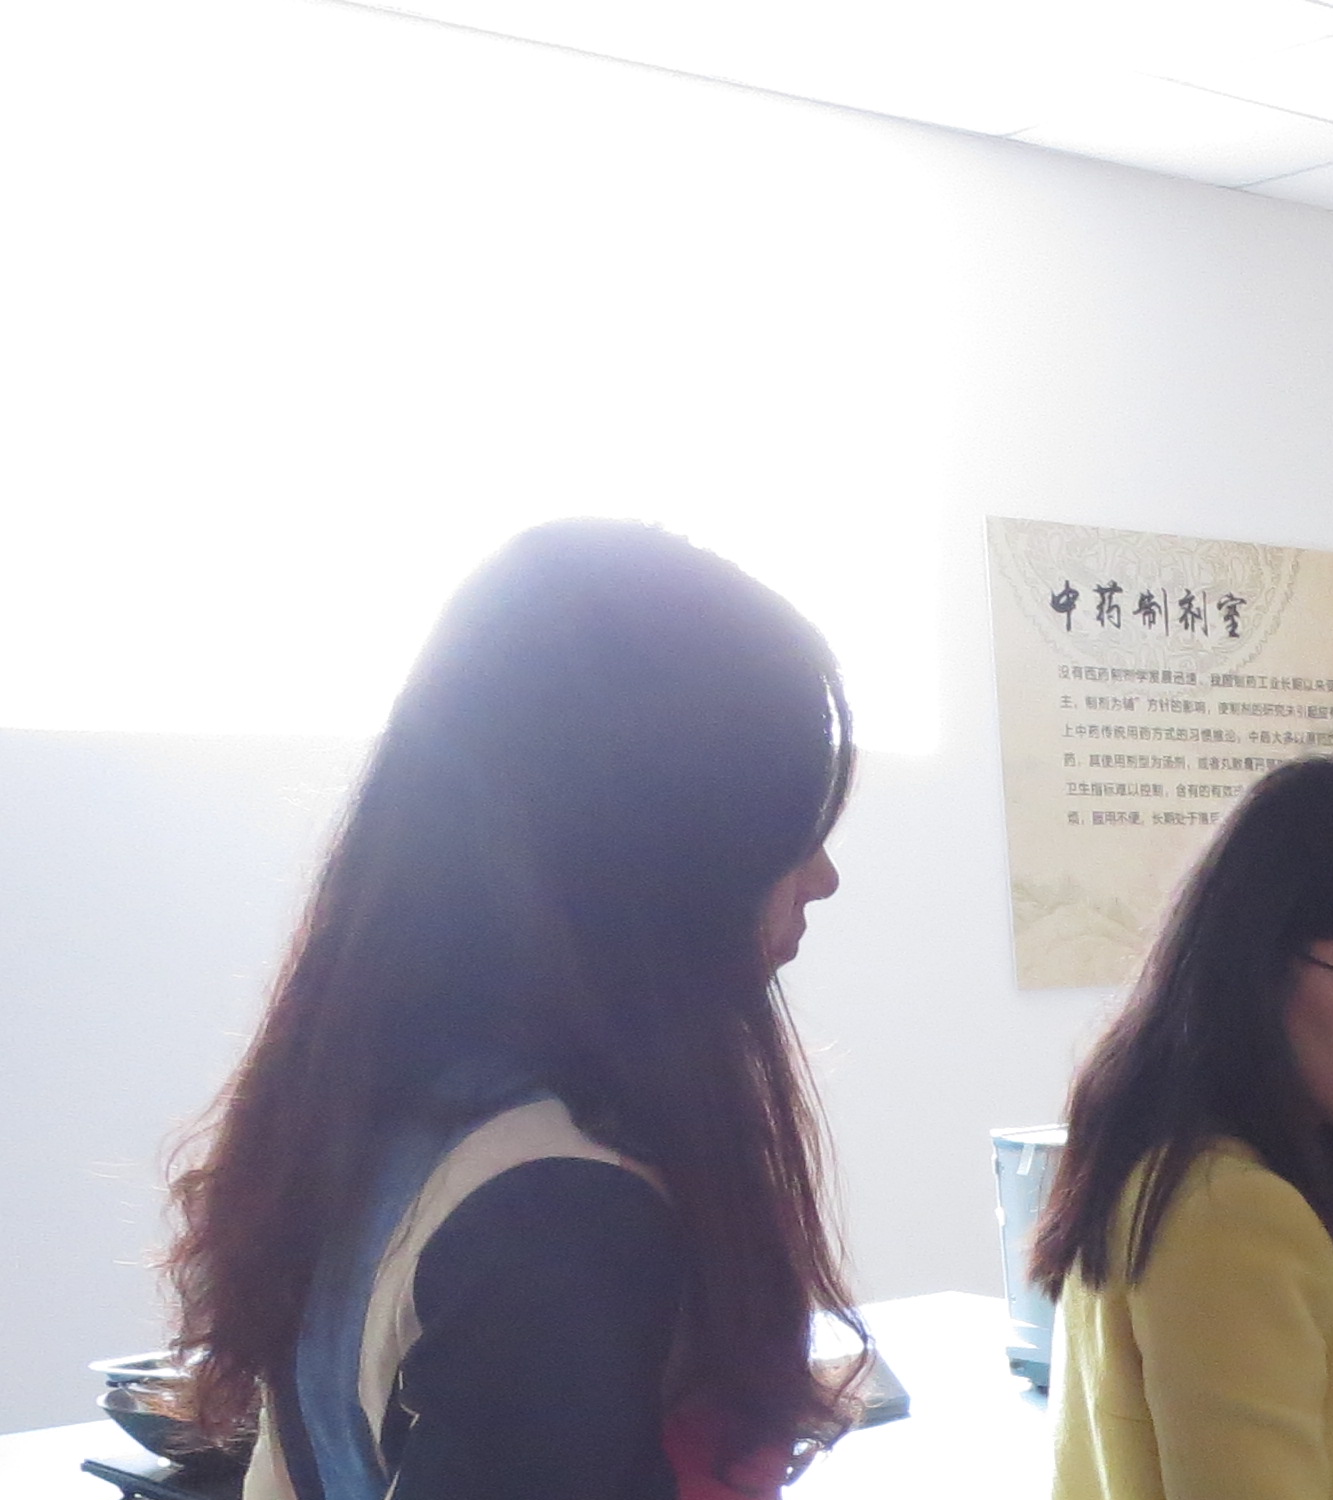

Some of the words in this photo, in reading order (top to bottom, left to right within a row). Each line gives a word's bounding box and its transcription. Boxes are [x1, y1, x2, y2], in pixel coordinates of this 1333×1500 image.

[1050, 580, 1247, 638] 中药制剂室
